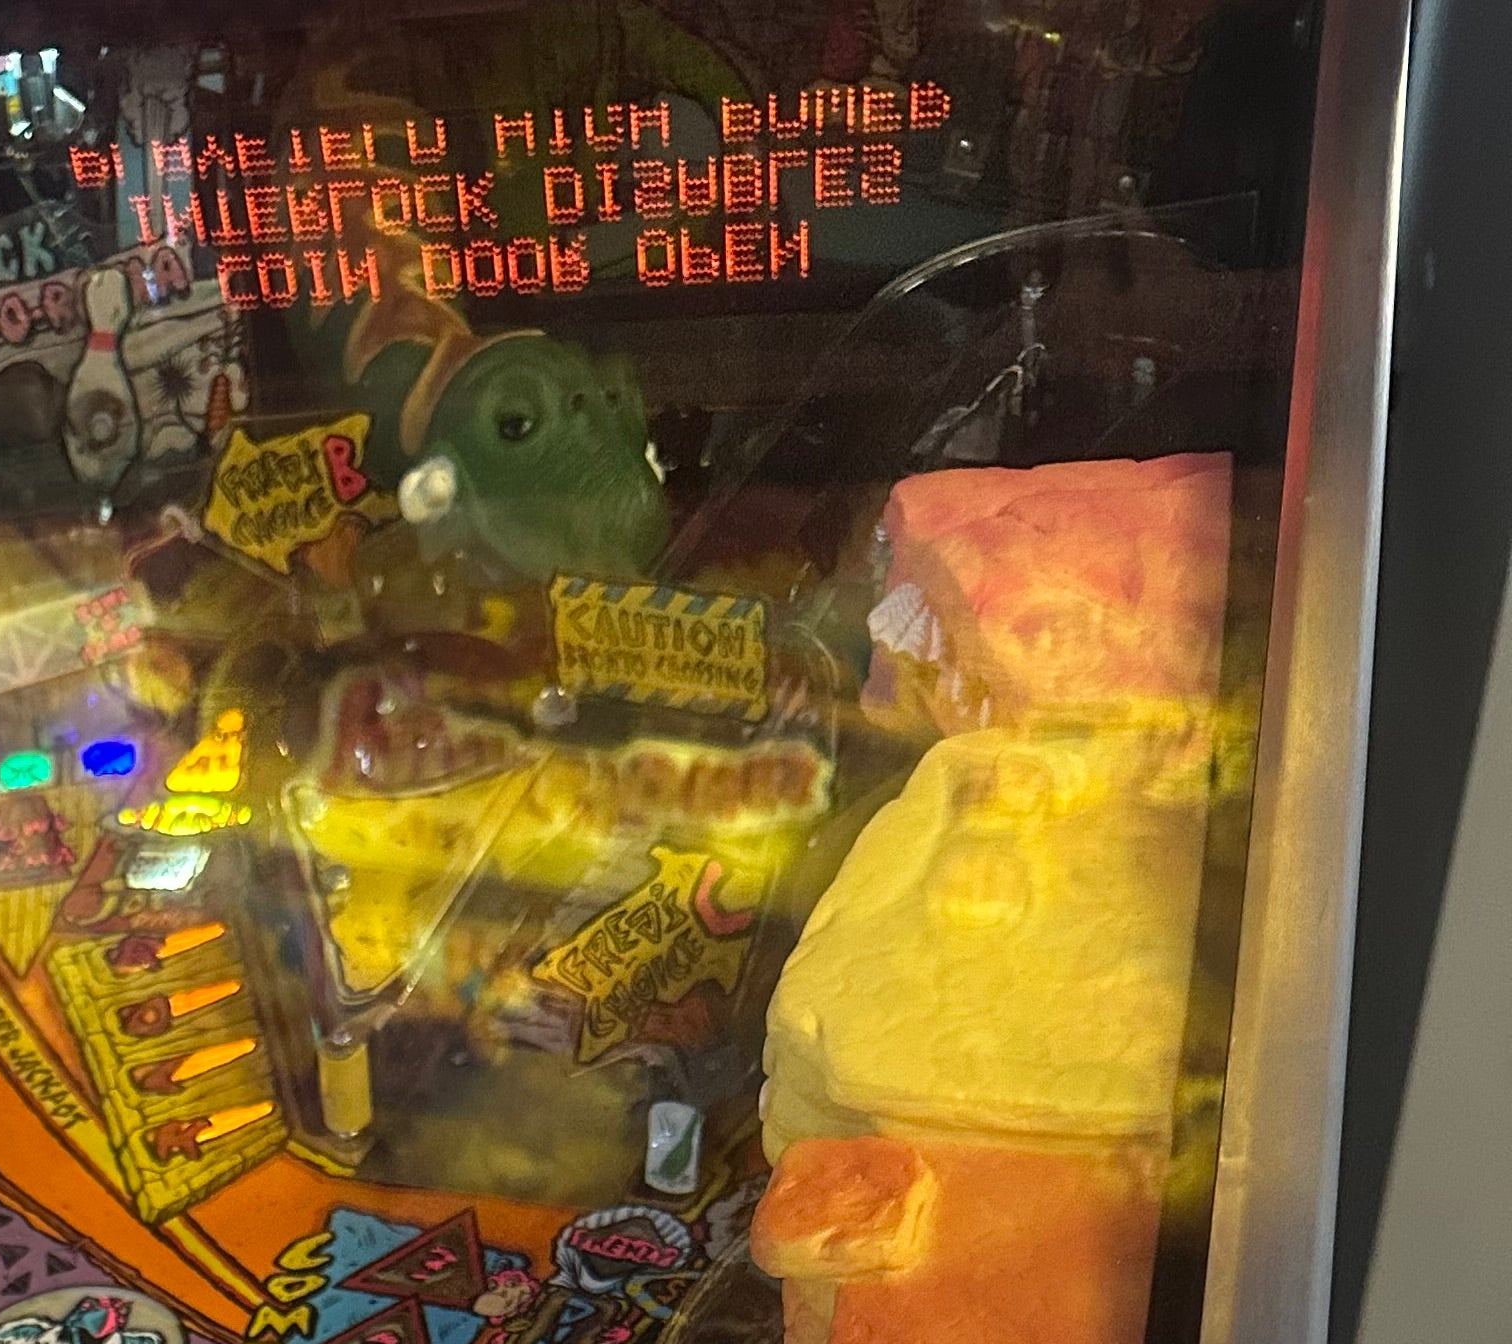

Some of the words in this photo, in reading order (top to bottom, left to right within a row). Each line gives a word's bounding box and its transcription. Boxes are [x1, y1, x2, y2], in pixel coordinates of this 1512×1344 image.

[322, 434, 368, 503] B
[567, 602, 745, 660] CAUTION
[694, 858, 758, 938] C
[555, 883, 689, 994] FRED'S
[589, 927, 705, 1039] CHOICE
